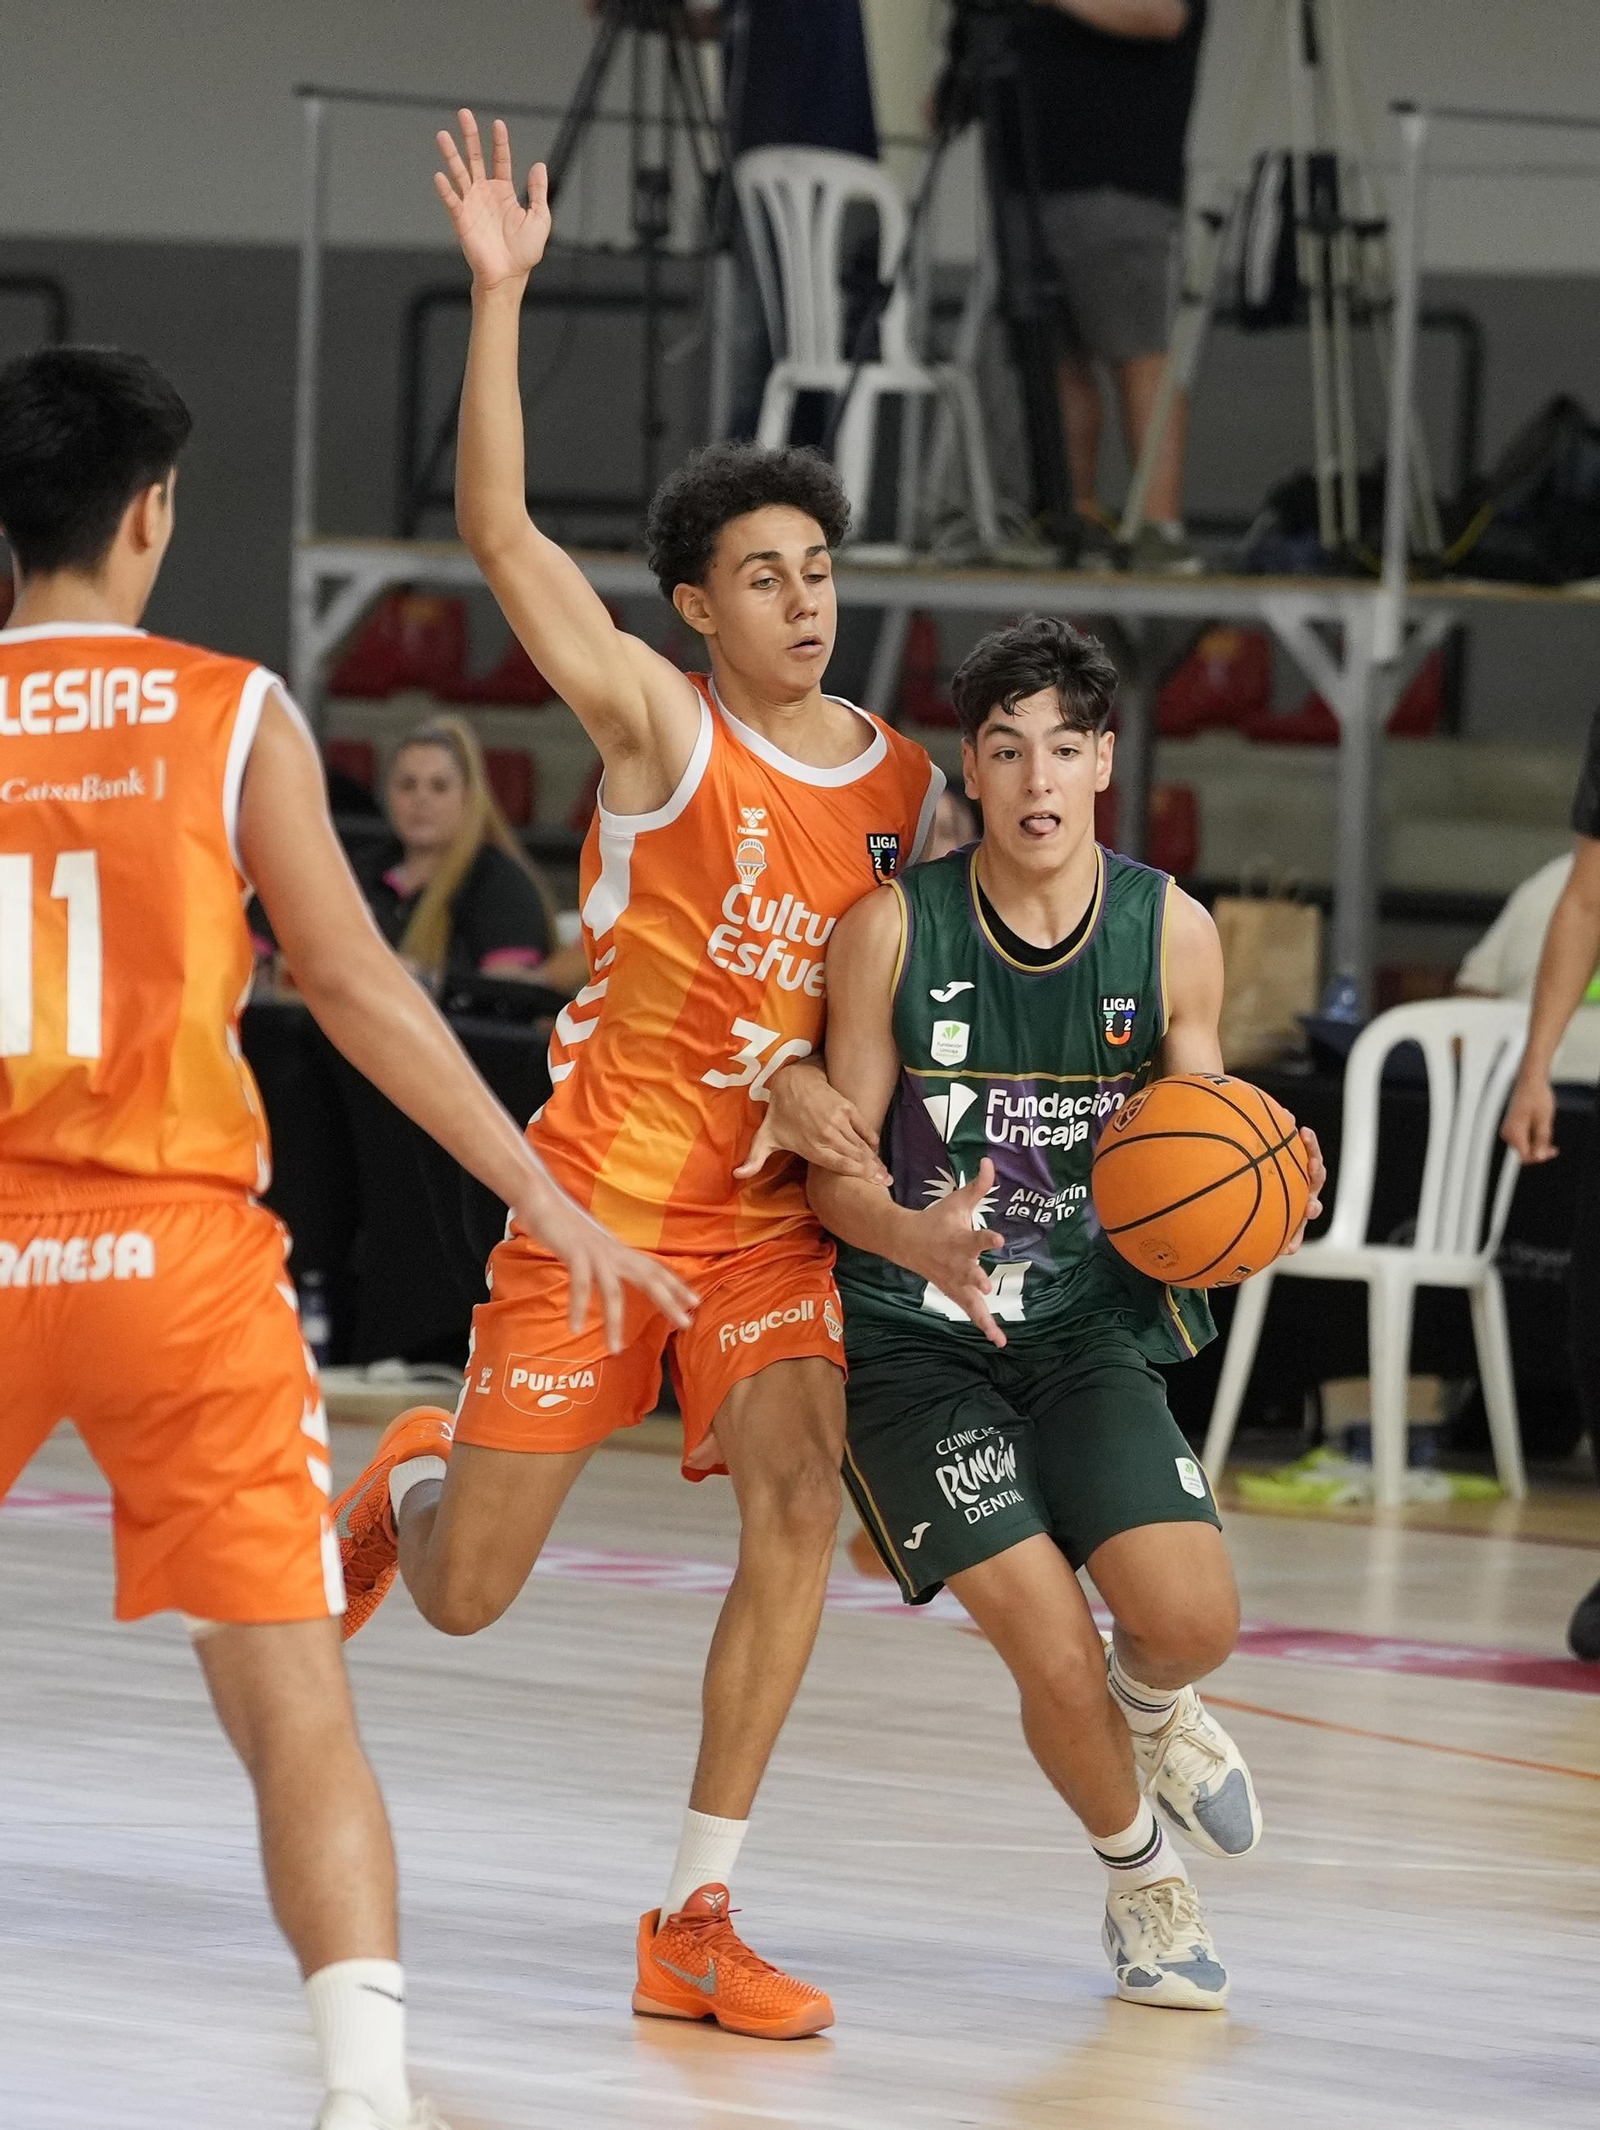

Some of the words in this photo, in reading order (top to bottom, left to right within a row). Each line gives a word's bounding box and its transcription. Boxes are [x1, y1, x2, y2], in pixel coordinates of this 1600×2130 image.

[0, 667, 179, 737] LESIAS
[870, 836, 897, 849] LIGA
[721, 883, 837, 947] Cultu
[706, 923, 827, 997] Esfue
[1102, 998, 1136, 1011] LIGA
[986, 1088, 1126, 1120] Fundación
[984, 1115, 1090, 1152] Unicaja
[1005, 1202, 1031, 1218] de
[1033, 1208, 1053, 1223] la
[1054, 1203, 1080, 1221] To
[510, 1367, 596, 1392] PULEVA
[963, 1488, 1025, 1525] DENTAL
